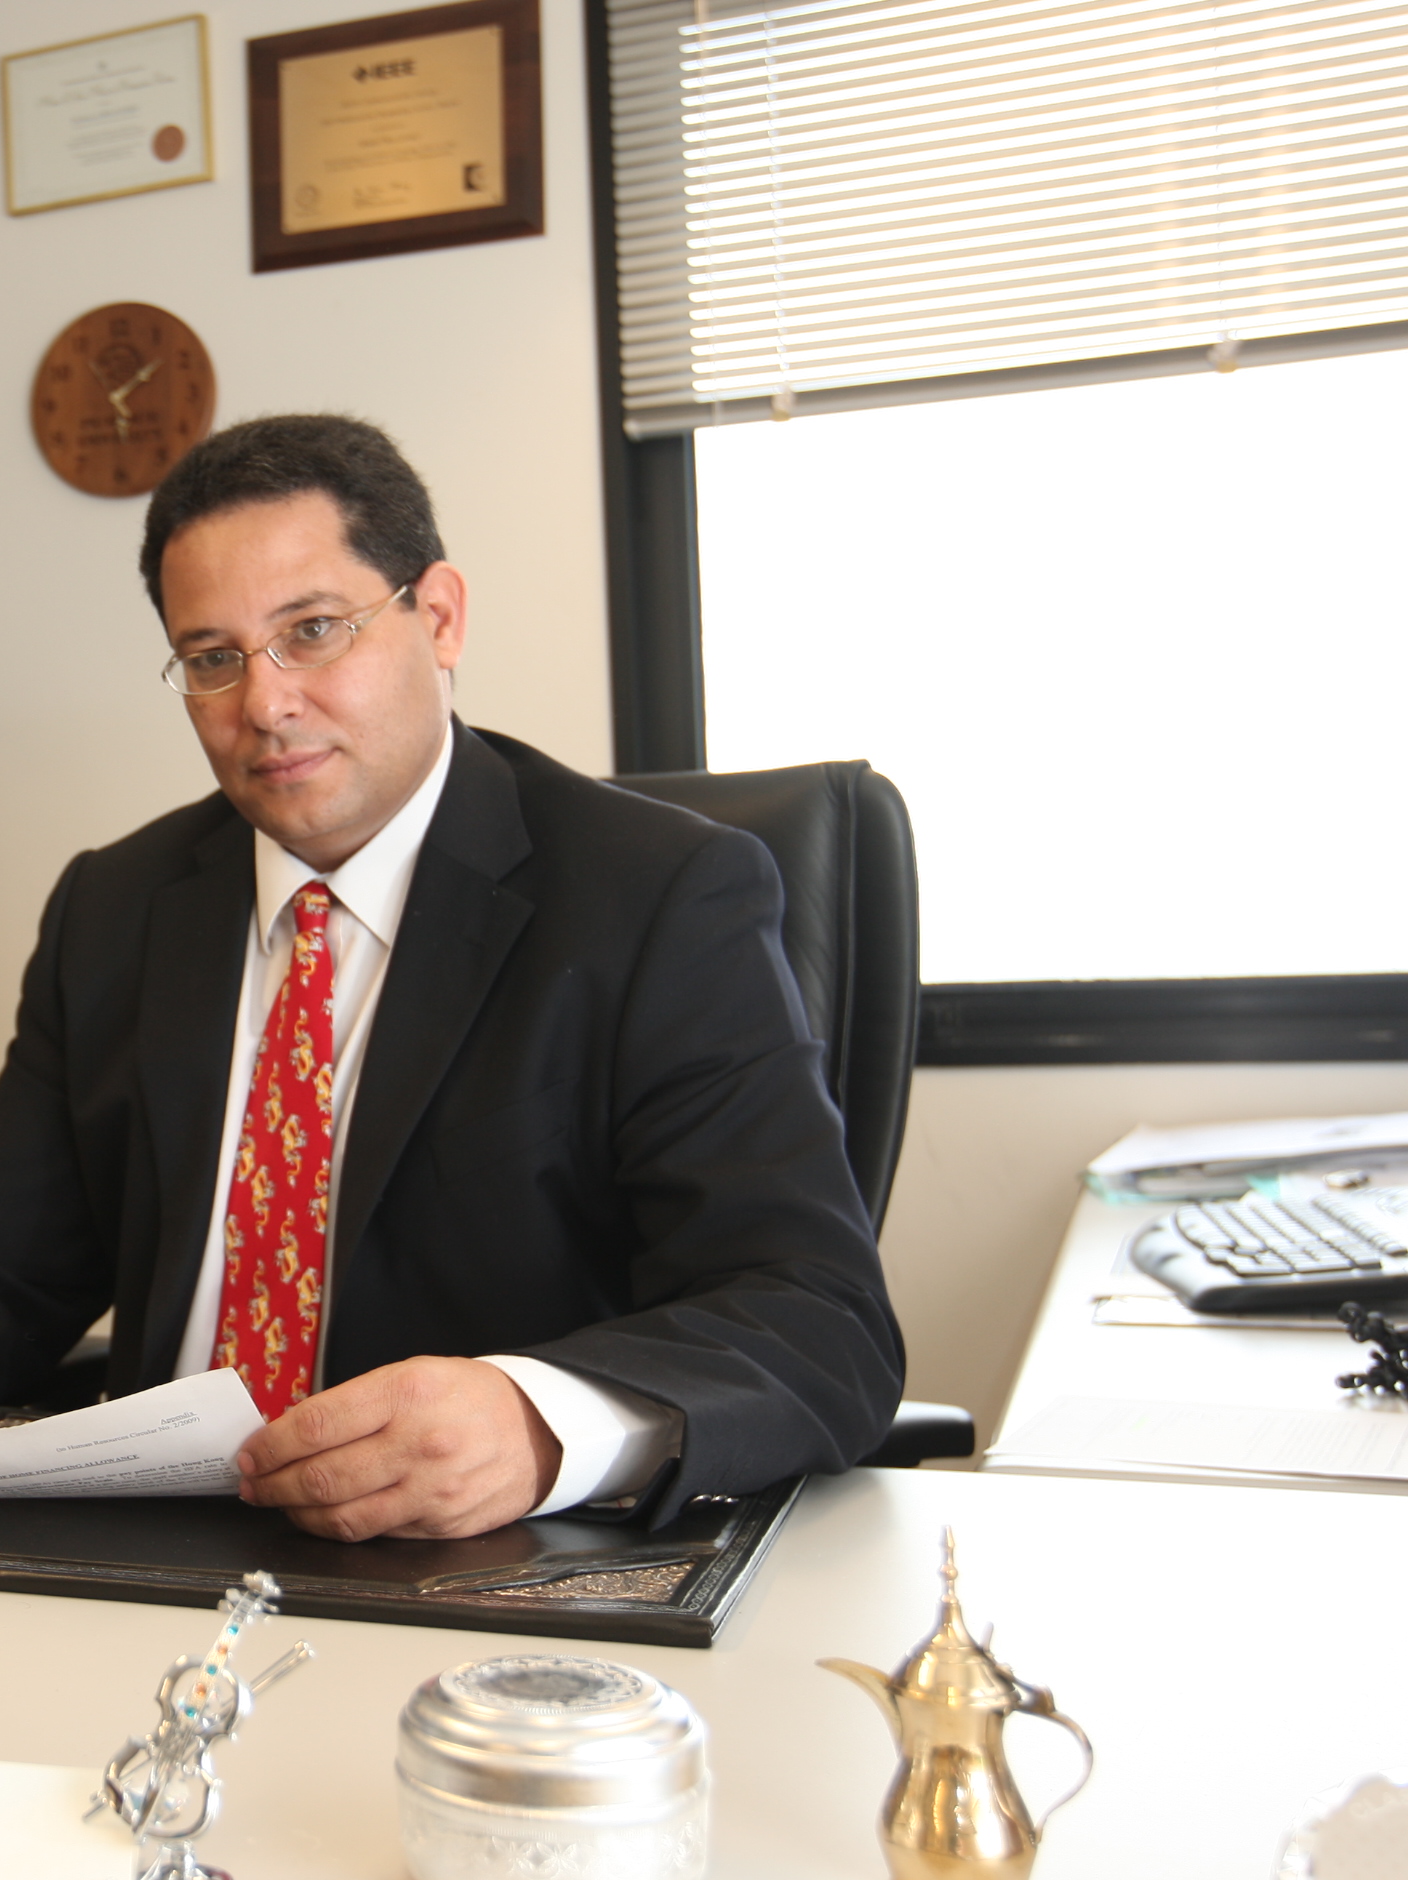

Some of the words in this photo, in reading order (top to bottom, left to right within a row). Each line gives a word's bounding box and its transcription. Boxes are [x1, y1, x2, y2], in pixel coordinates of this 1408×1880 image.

[160, 1411, 197, 1425] Appendix
[67, 1443, 93, 1451] Human
[93, 1435, 129, 1446] Resources
[129, 1428, 157, 1439] Circular
[159, 1424, 172, 1432] No.
[84, 1454, 140, 1468] ALLOWANCE
